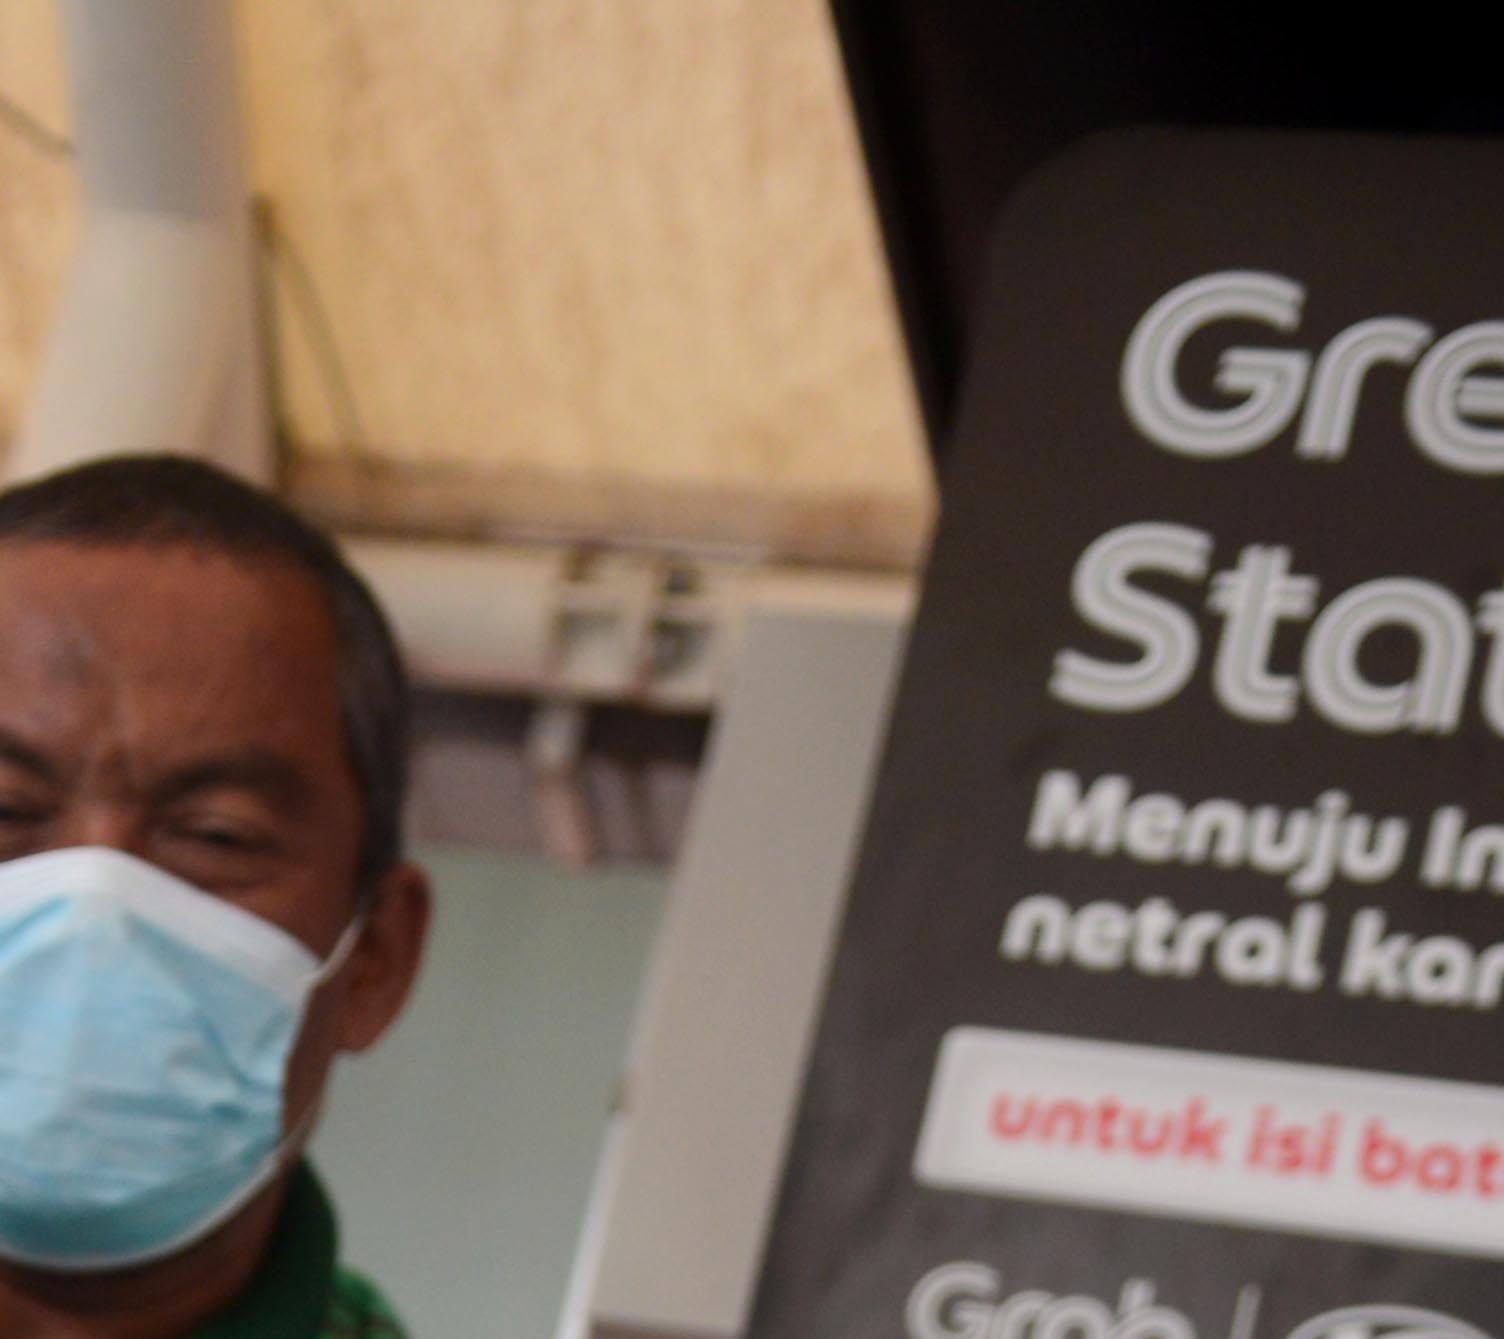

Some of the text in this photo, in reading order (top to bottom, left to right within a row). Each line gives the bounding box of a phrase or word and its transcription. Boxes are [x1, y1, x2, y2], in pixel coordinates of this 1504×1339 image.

[1028, 769, 1408, 894] Menuju
[1002, 892, 1327, 992] netral
[989, 1085, 1221, 1168] untuk
[1246, 1101, 1338, 1178] isi
